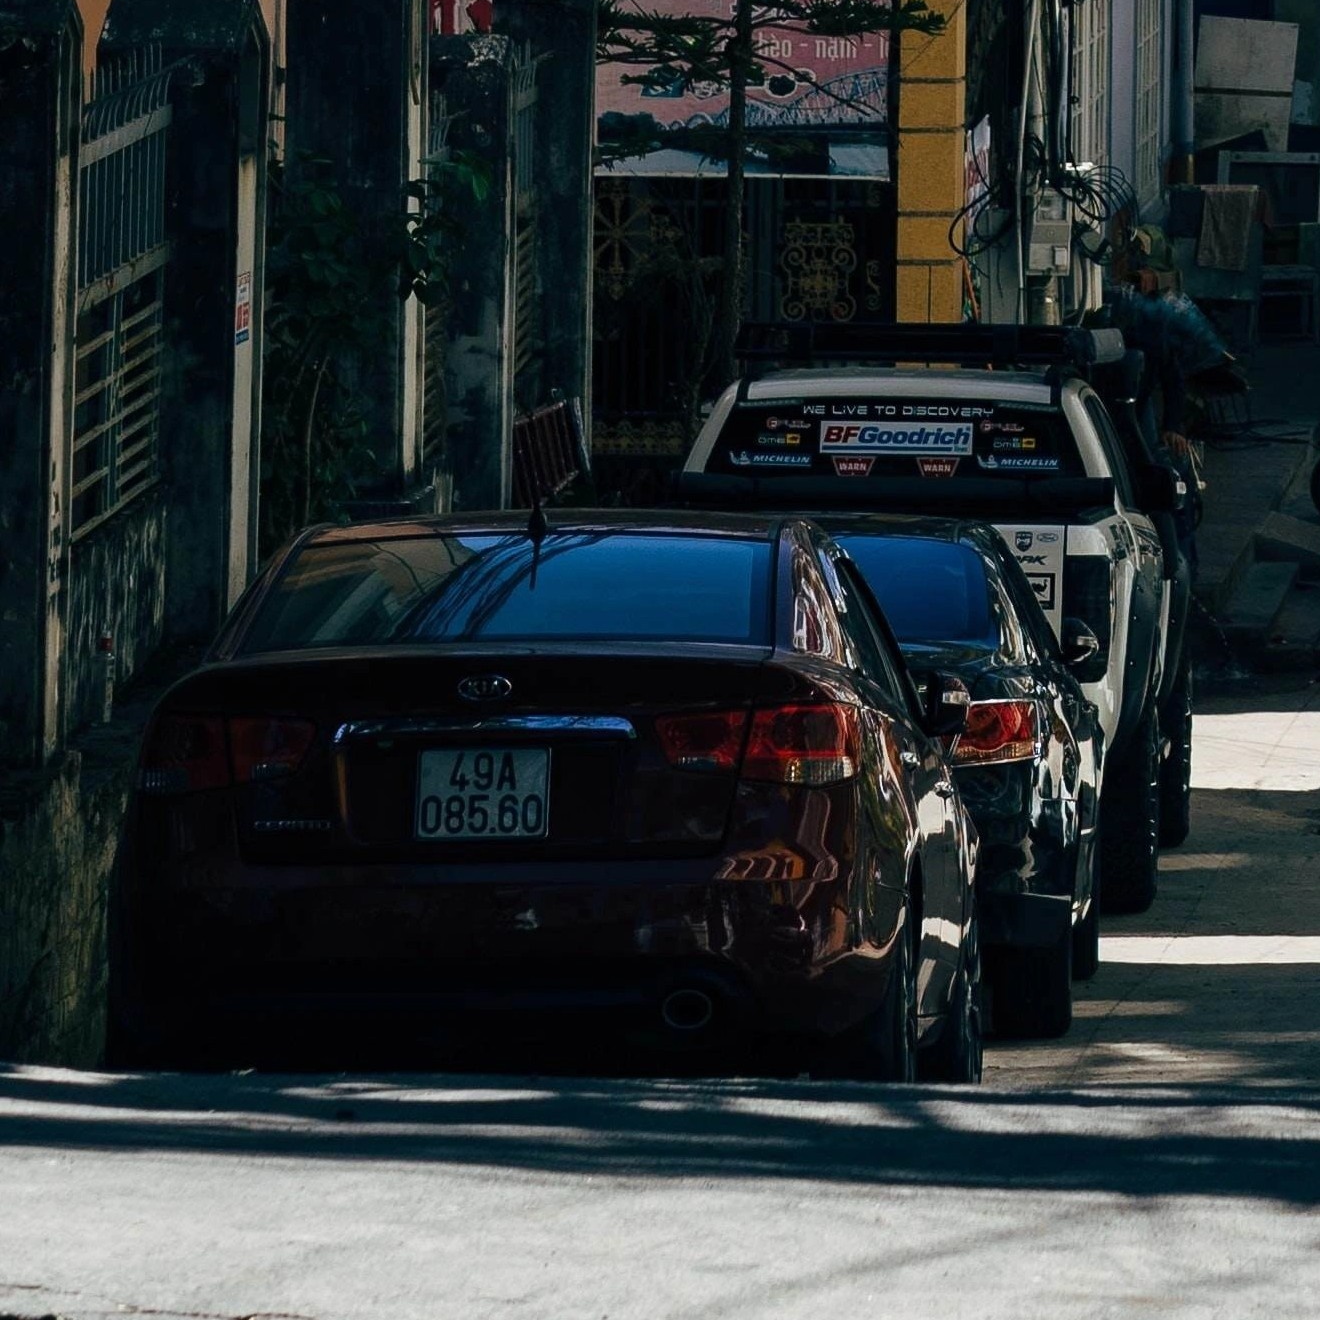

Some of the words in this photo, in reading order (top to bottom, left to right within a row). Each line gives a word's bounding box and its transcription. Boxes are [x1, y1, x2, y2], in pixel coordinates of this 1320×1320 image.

[803, 405, 825, 415] WE
[874, 405, 897, 416] TO
[823, 425, 971, 446] BFGoodrich
[753, 455, 811, 463] MICHELIN
[839, 461, 868, 473] WARN
[923, 462, 952, 474] WARN
[465, 680, 504, 695] KIA
[449, 752, 517, 792] 49A
[420, 794, 544, 834] 085.60
